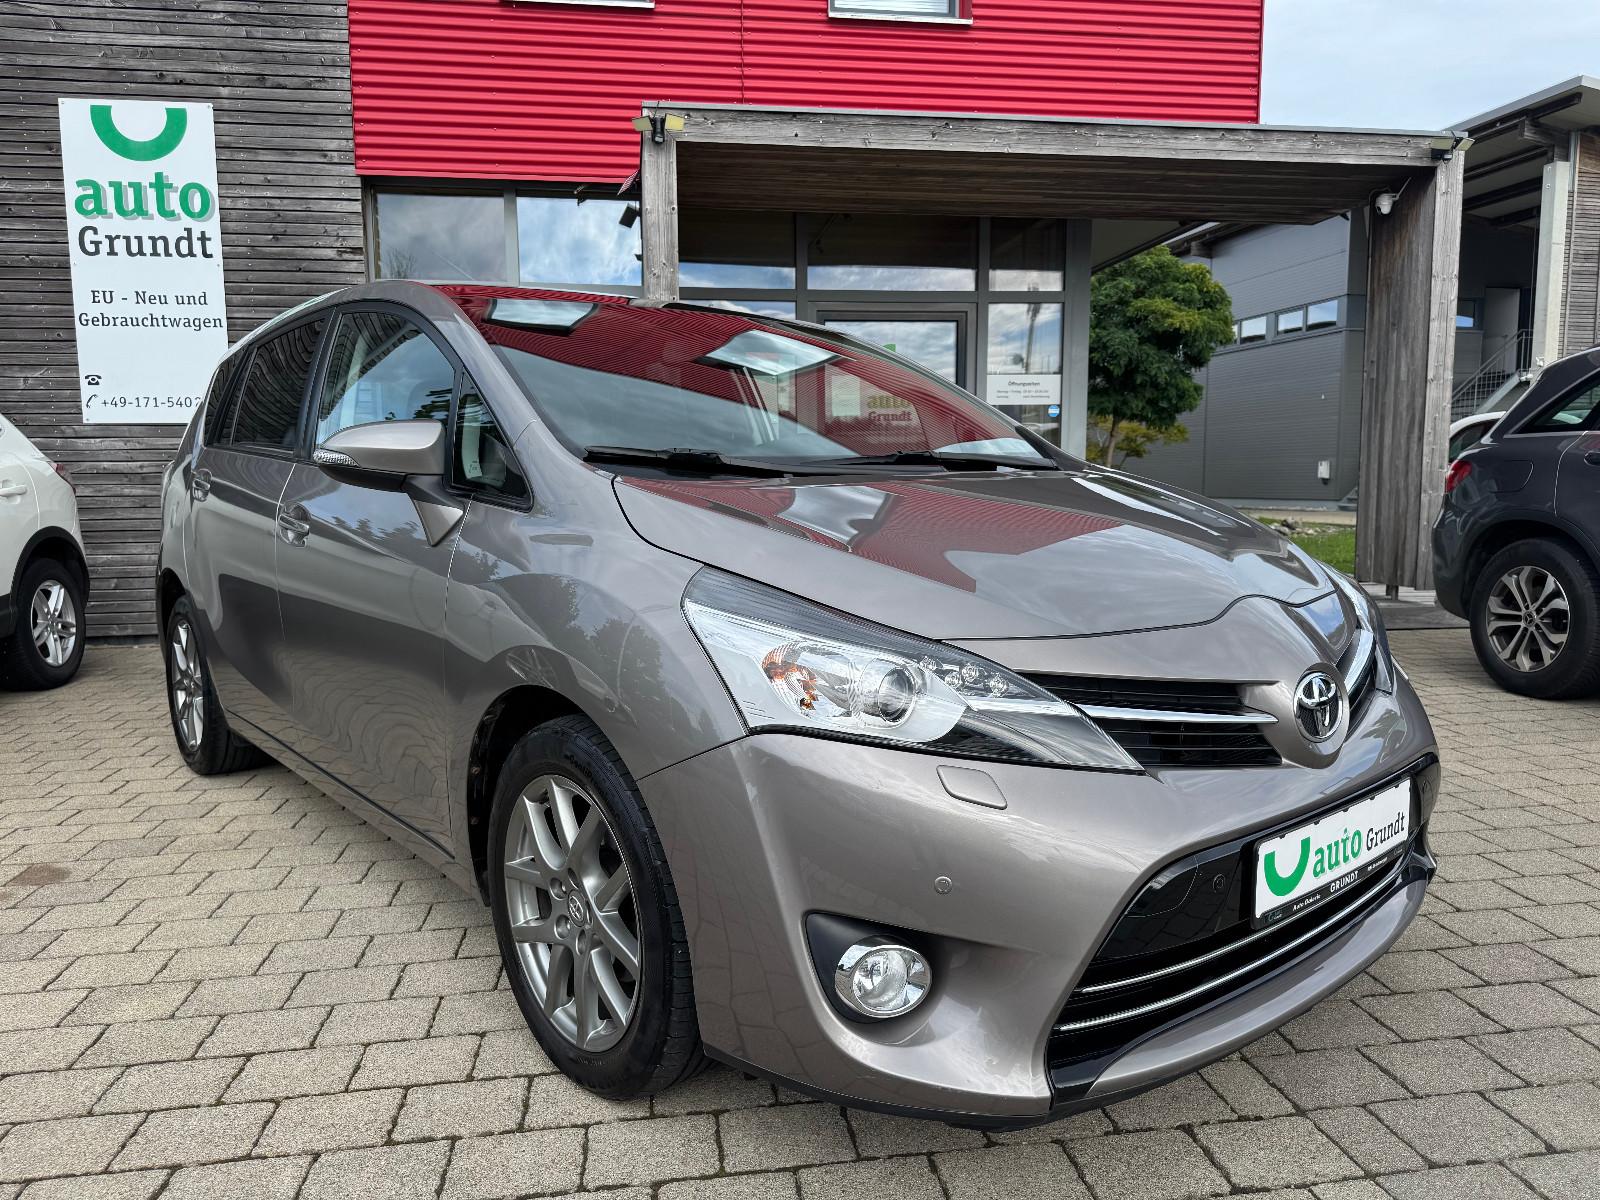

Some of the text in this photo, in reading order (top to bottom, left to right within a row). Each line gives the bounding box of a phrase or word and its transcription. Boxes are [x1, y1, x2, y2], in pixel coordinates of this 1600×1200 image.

[74, 172, 214, 221] auto
[78, 225, 213, 258] Grundt
[90, 290, 114, 304] EU
[134, 291, 169, 305] Neu
[174, 291, 208, 306] und
[78, 312, 224, 331] Gebrauchtwagen
[1312, 811, 1405, 878] auto Grundt
[1330, 870, 1359, 893] GRUNDT
